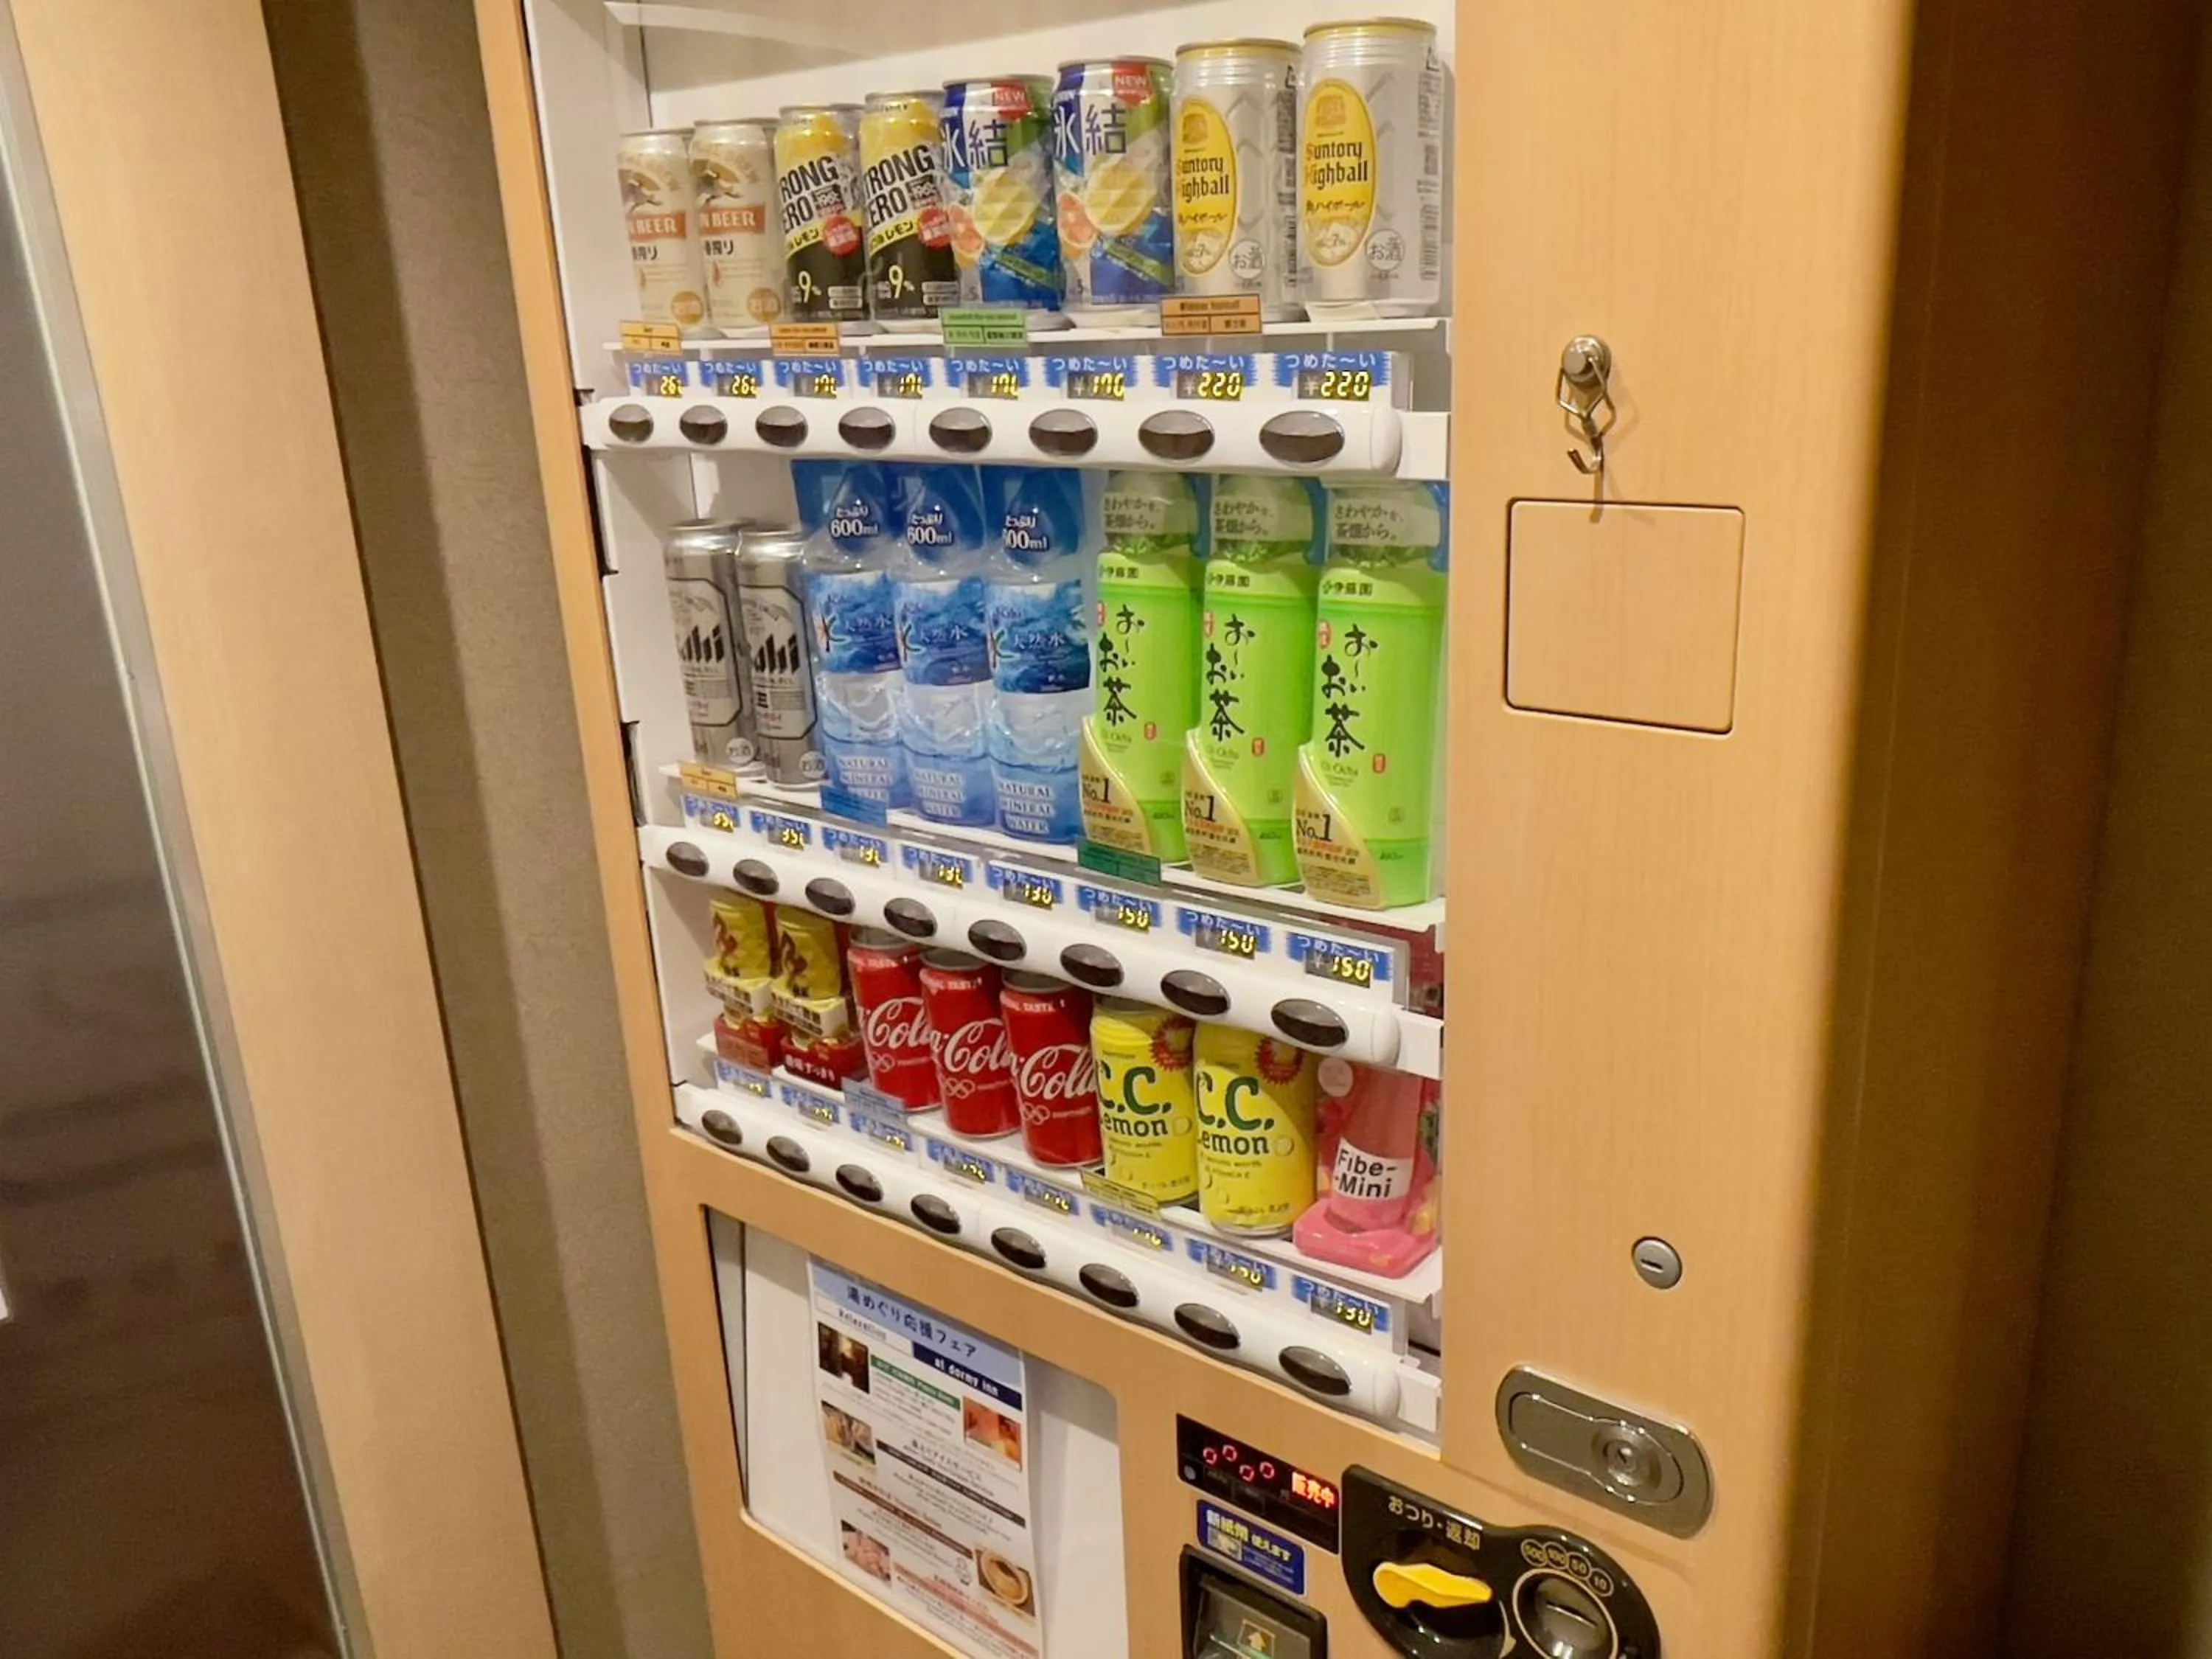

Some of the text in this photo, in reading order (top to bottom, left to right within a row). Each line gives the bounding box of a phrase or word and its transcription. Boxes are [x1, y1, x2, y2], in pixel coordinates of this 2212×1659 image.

[1113, 73, 1147, 87] NEW
[994, 89, 1026, 103] NEW
[1054, 103, 1127, 159] 氷結
[940, 119, 1008, 173] 氷結
[636, 217, 678, 234] BEER
[712, 211, 756, 228] BEER
[1162, 355, 1245, 370] つめた～い
[1285, 353, 1376, 369] つめた～い
[830, 519, 879, 538] 600ml
[907, 525, 953, 545] 600ml
[1082, 777, 1110, 804] No.1
[1184, 794, 1216, 822] No.1
[1295, 813, 1333, 843] No.1
[1101, 1112, 1169, 1137] emon
[1199, 1130, 1270, 1155] emon
[1388, 1495, 1481, 1551] おつり・返却
[1594, 1575, 1607, 1591] 10
